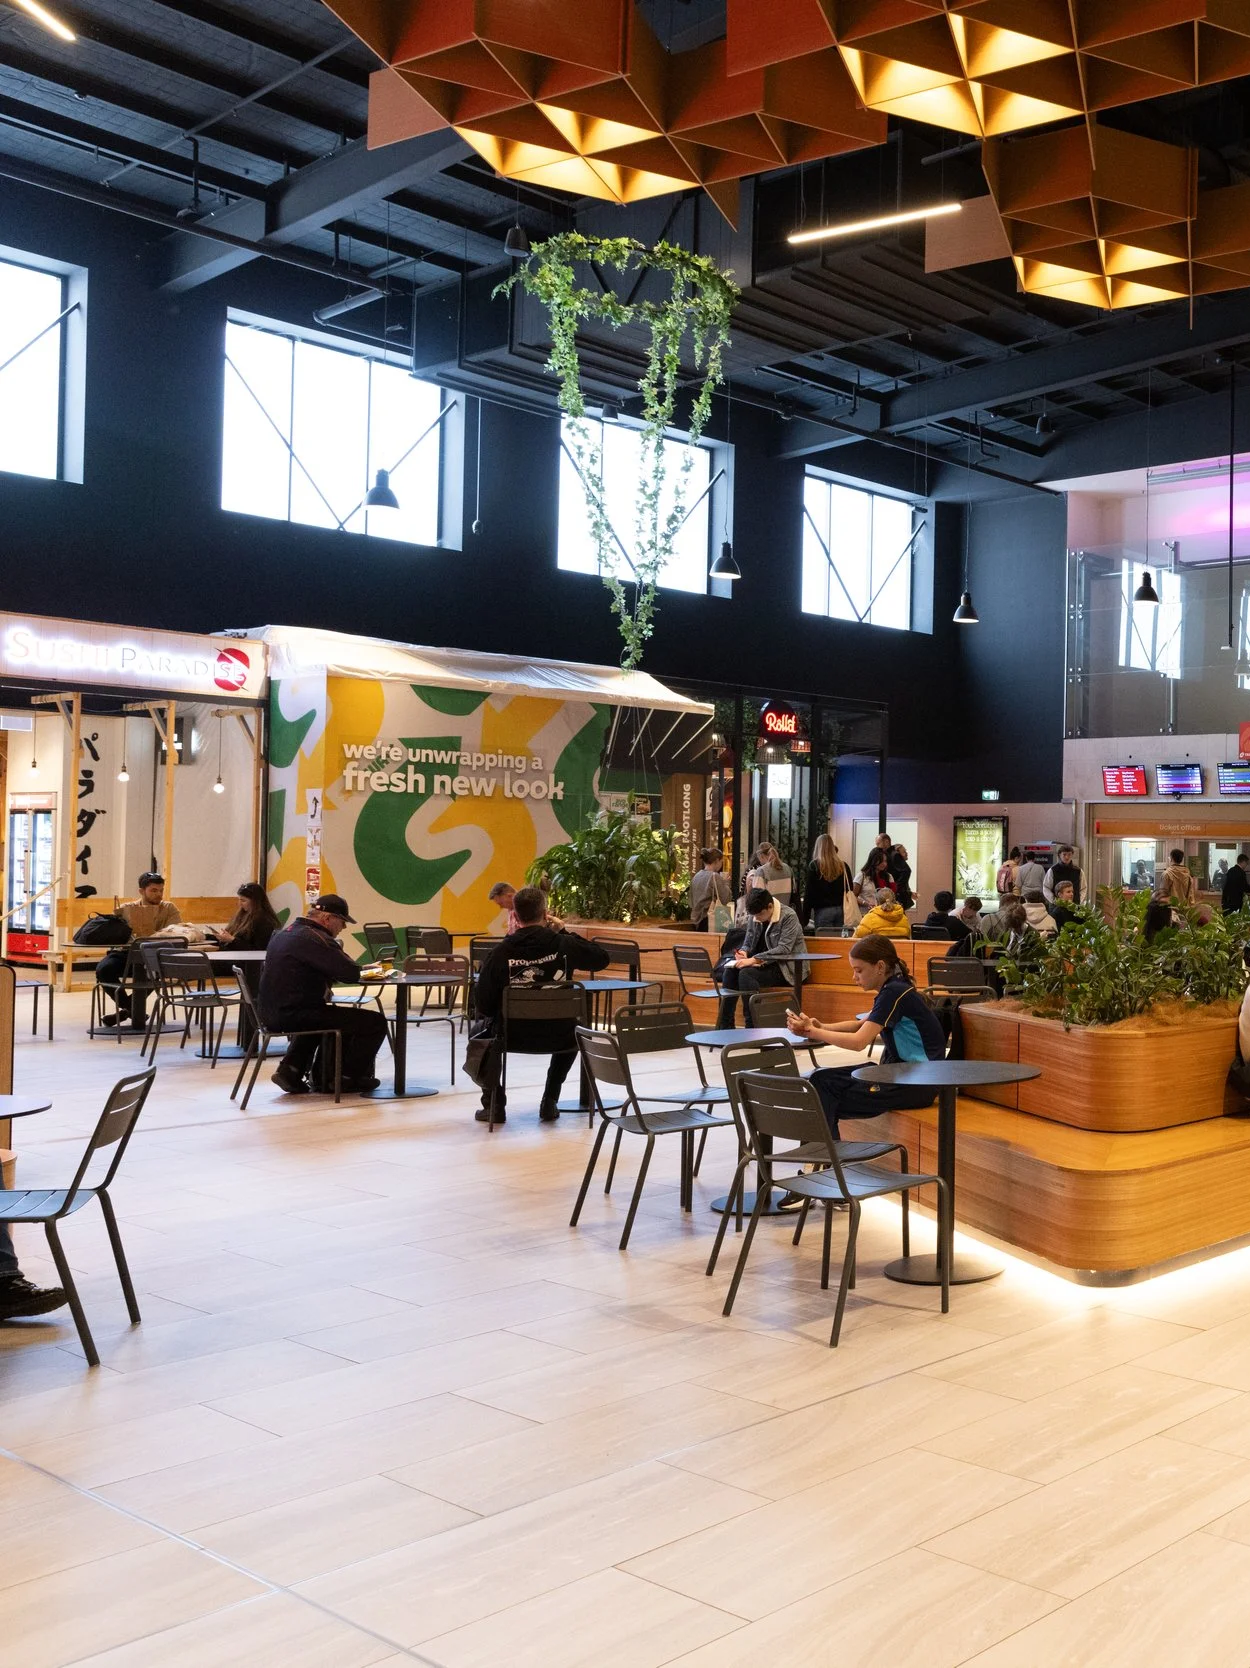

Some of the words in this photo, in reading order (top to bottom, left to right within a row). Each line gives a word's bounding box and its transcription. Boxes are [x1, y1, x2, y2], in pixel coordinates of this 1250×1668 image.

[342, 740, 403, 761] we're
[408, 747, 527, 773] unwrapping
[531, 755, 543, 770] a
[342, 760, 425, 793] fresh
[433, 772, 496, 797] new
[504, 771, 564, 800] look
[682, 783, 691, 843] FOOTLONG
